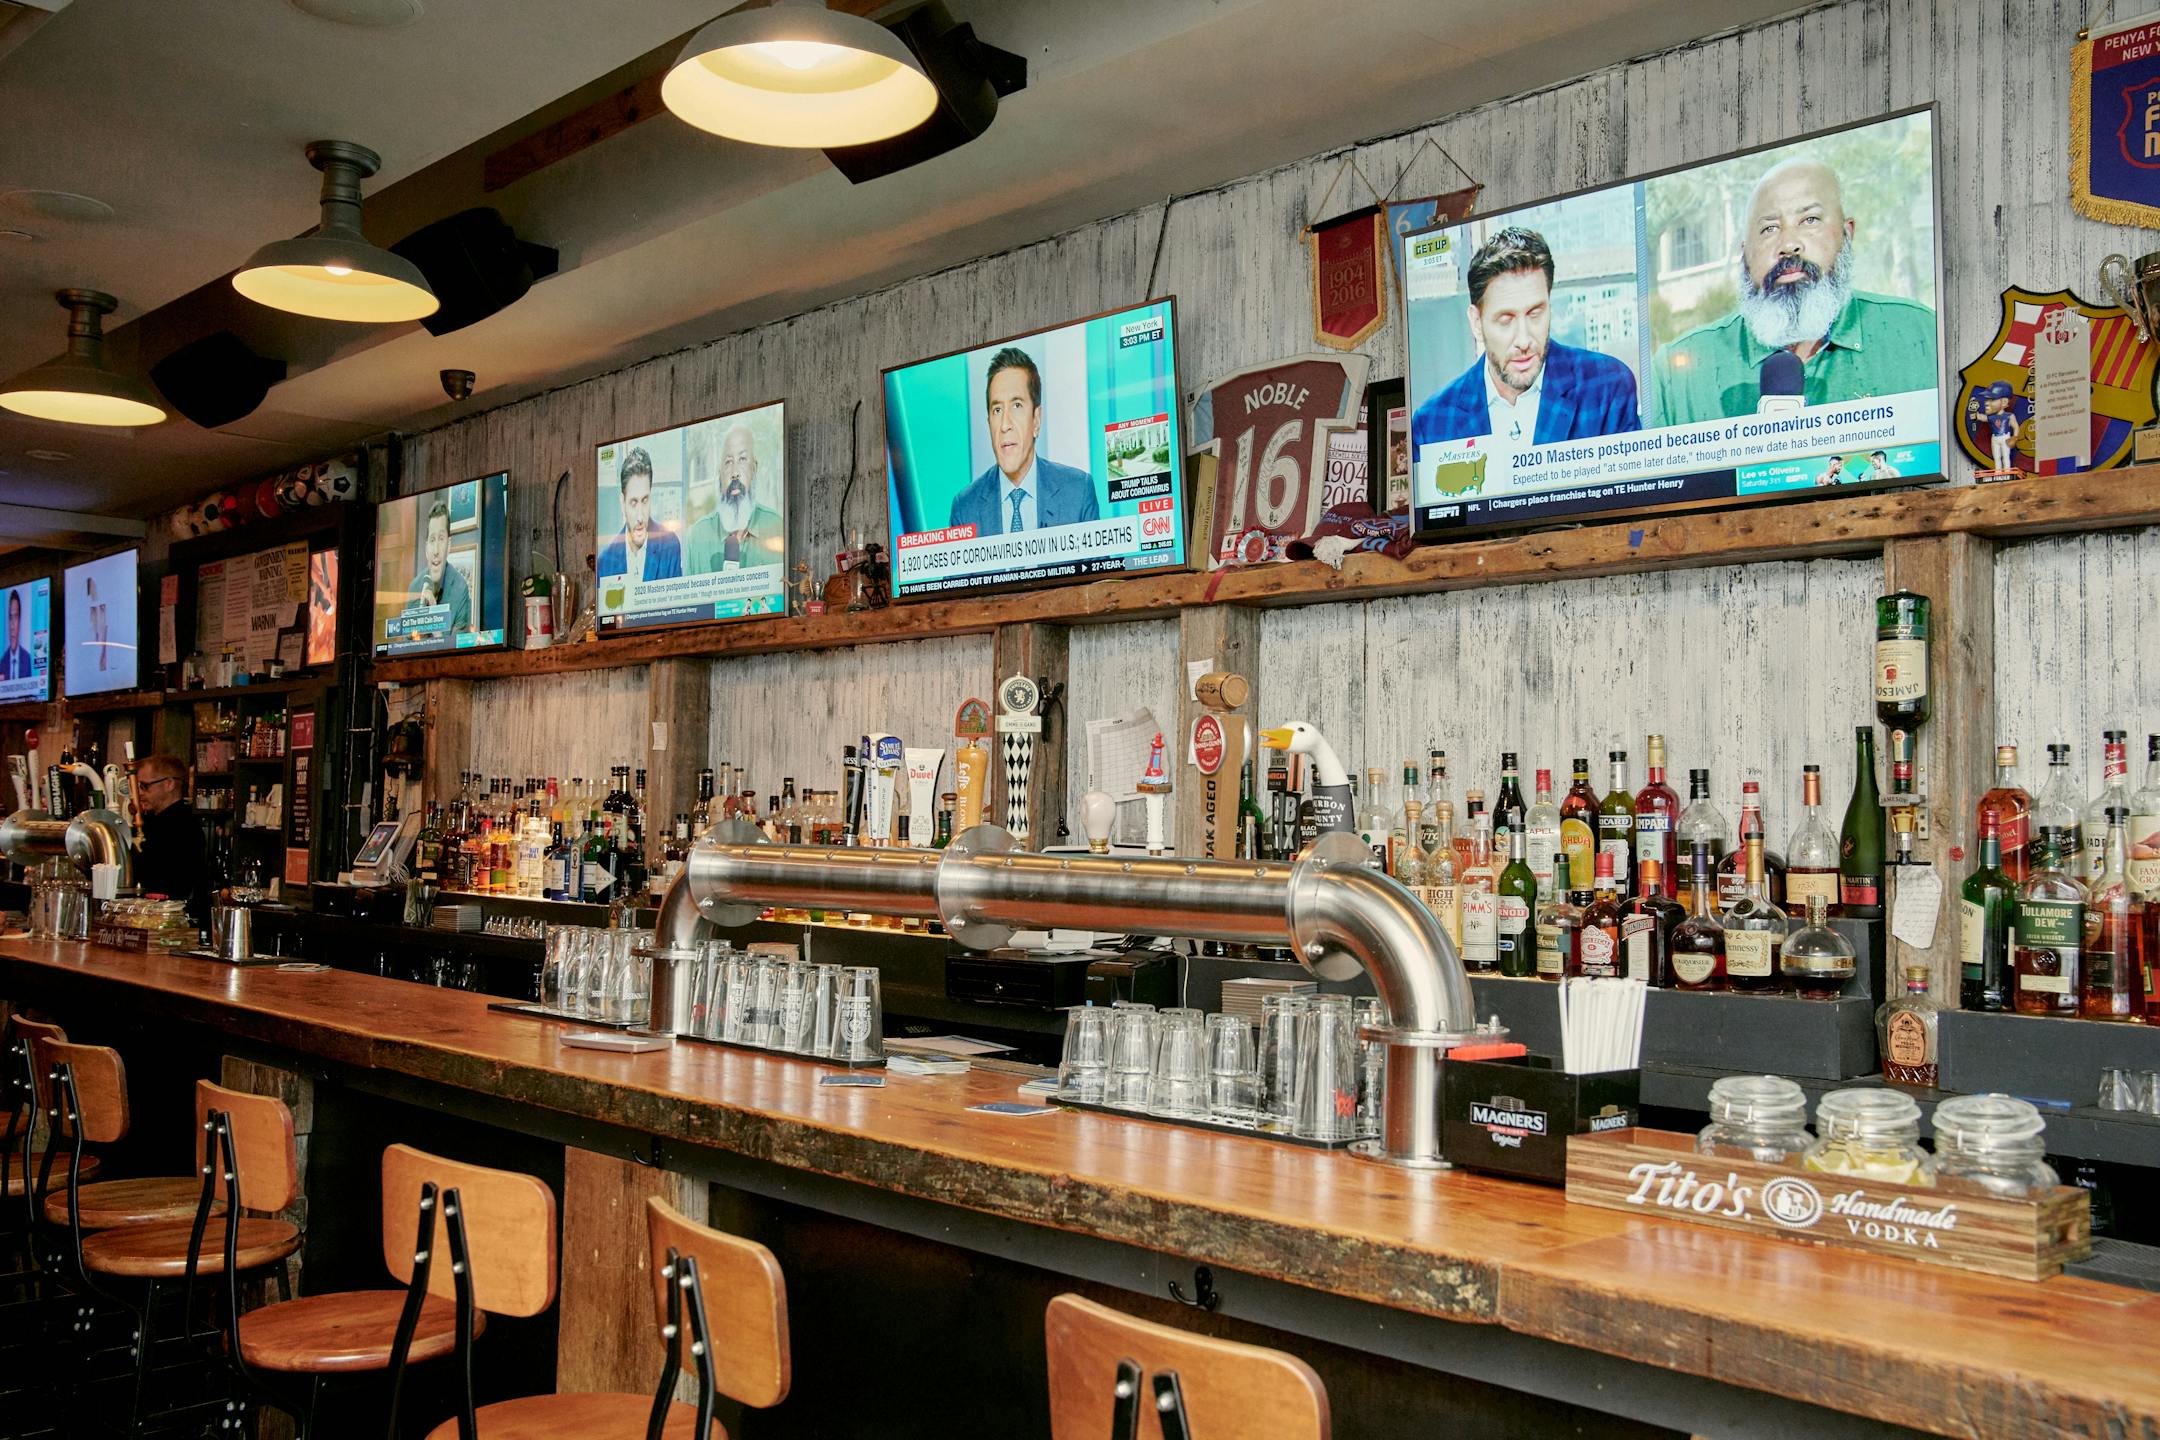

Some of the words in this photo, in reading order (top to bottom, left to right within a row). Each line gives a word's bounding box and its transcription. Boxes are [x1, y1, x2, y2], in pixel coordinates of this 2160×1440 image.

[2104, 30, 2145, 50] PENYA
[2122, 44, 2151, 61] NEW
[1395, 208, 1411, 235] 6
[1415, 242, 1433, 255] GET
[1435, 239, 1447, 250] UP
[1328, 264, 1365, 290] 1904
[1328, 282, 1366, 306] 2016
[1125, 324, 1140, 334] New
[1142, 319, 1158, 330] York
[1123, 336, 1137, 347] 3:03
[1138, 333, 1150, 343] PM
[1151, 330, 1161, 340] ET
[1244, 382, 1310, 414] NOBLE
[1118, 421, 1130, 429] ANY
[1130, 417, 1154, 427] MOMENT
[1512, 452, 1542, 468] 2020
[1547, 446, 1594, 463] Masters
[1599, 434, 1662, 457] postponed
[1666, 430, 1720, 447] because
[1725, 424, 1738, 440] of
[1743, 415, 1822, 438] coronavirus
[1827, 405, 1894, 426] concerns
[1513, 470, 1548, 485] Expected
[1550, 469, 1559, 480] to
[1561, 467, 1571, 478] be
[1574, 464, 1600, 479] played
[1604, 461, 1616, 472] "at
[1618, 461, 1641, 471] some
[1644, 456, 1664, 468] later
[1667, 451, 1693, 465] date,"
[1696, 447, 1727, 461] though
[1730, 447, 1741, 457] no
[1745, 444, 1764, 455] new
[1767, 441, 1787, 453] date
[1791, 438, 1808, 450] has
[1811, 435, 1835, 447] been
[1839, 425, 1895, 443] announced
[1228, 419, 1303, 533] 16
[1325, 460, 1368, 486] 1904
[1741, 471, 1756, 479] Lee
[1769, 466, 1800, 475] Oliveira
[1111, 489, 1130, 501] ABOUT
[1130, 483, 1170, 497] CORONAVIRUS
[1120, 478, 1140, 490] TRUMP
[1141, 475, 1159, 486] TALKS
[1742, 478, 1768, 487] Saturday
[1322, 484, 1366, 506] 2016
[1428, 505, 1460, 520] ESPN
[1468, 503, 1481, 513] NFL
[1493, 494, 1526, 509] Chargers
[1528, 494, 1549, 506] place
[1550, 490, 1586, 503] franchise
[1588, 488, 1601, 500] tag
[1602, 487, 1613, 497] on
[1615, 485, 1626, 495] TE
[1627, 481, 1656, 493] Hunter
[1658, 478, 1684, 490] Henry
[1142, 499, 1169, 512] LIVE
[1143, 516, 1171, 536] CNN
[901, 531, 944, 547] BREAKING
[946, 527, 973, 540] NEWS
[902, 555, 921, 575] 1,920
[923, 552, 948, 570] CASES
[951, 550, 961, 567] OF
[963, 541, 1022, 564] CORONAVIRUS
[1025, 539, 1046, 556] NOW
[1048, 537, 1058, 553] IN
[1082, 532, 1092, 549] 41
[1095, 526, 1132, 547] DEATHS
[1133, 557, 1148, 567] THE
[1149, 554, 1169, 565] LEAD
[634, 586, 646, 595] 2020
[648, 584, 665, 594] Masters
[691, 578, 710, 587] because
[711, 577, 717, 586] of
[746, 571, 769, 581] concerns
[901, 586, 909, 594] TO
[910, 584, 926, 593] HAVE
[926, 582, 942, 591] BEEN
[943, 579, 969, 589] CARRIED
[970, 577, 983, 586] OUT
[984, 575, 992, 584] BY
[993, 569, 1046, 583] IRANIAN-BACKED
[1047, 566, 1076, 577] MILITIAS
[880, 740, 901, 751] SAMUEL
[881, 748, 900, 757] ADAMS
[844, 757, 858, 766] NESS
[50, 771, 61, 795] LIGHT
[909, 768, 934, 779] Duvel
[958, 763, 971, 789] Leffe
[53, 797, 62, 815] BUD
[1206, 780, 1216, 825] AGED
[1846, 877, 1871, 886] MARTIN
[1463, 900, 1493, 914] PIMM'S
[2020, 904, 2073, 917] TULLAMORE
[2035, 917, 2057, 927] DEW
[98, 929, 115, 945] Tito's
[1473, 1106, 1544, 1131] MAGNERS
[1591, 1115, 1628, 1133] MAGNERS
[1491, 1133, 1522, 1148] Original
[1625, 1160, 1753, 1221] Tito's
[1831, 1190, 1957, 1231] Handmade
[1846, 1219, 1939, 1250] VODKA
